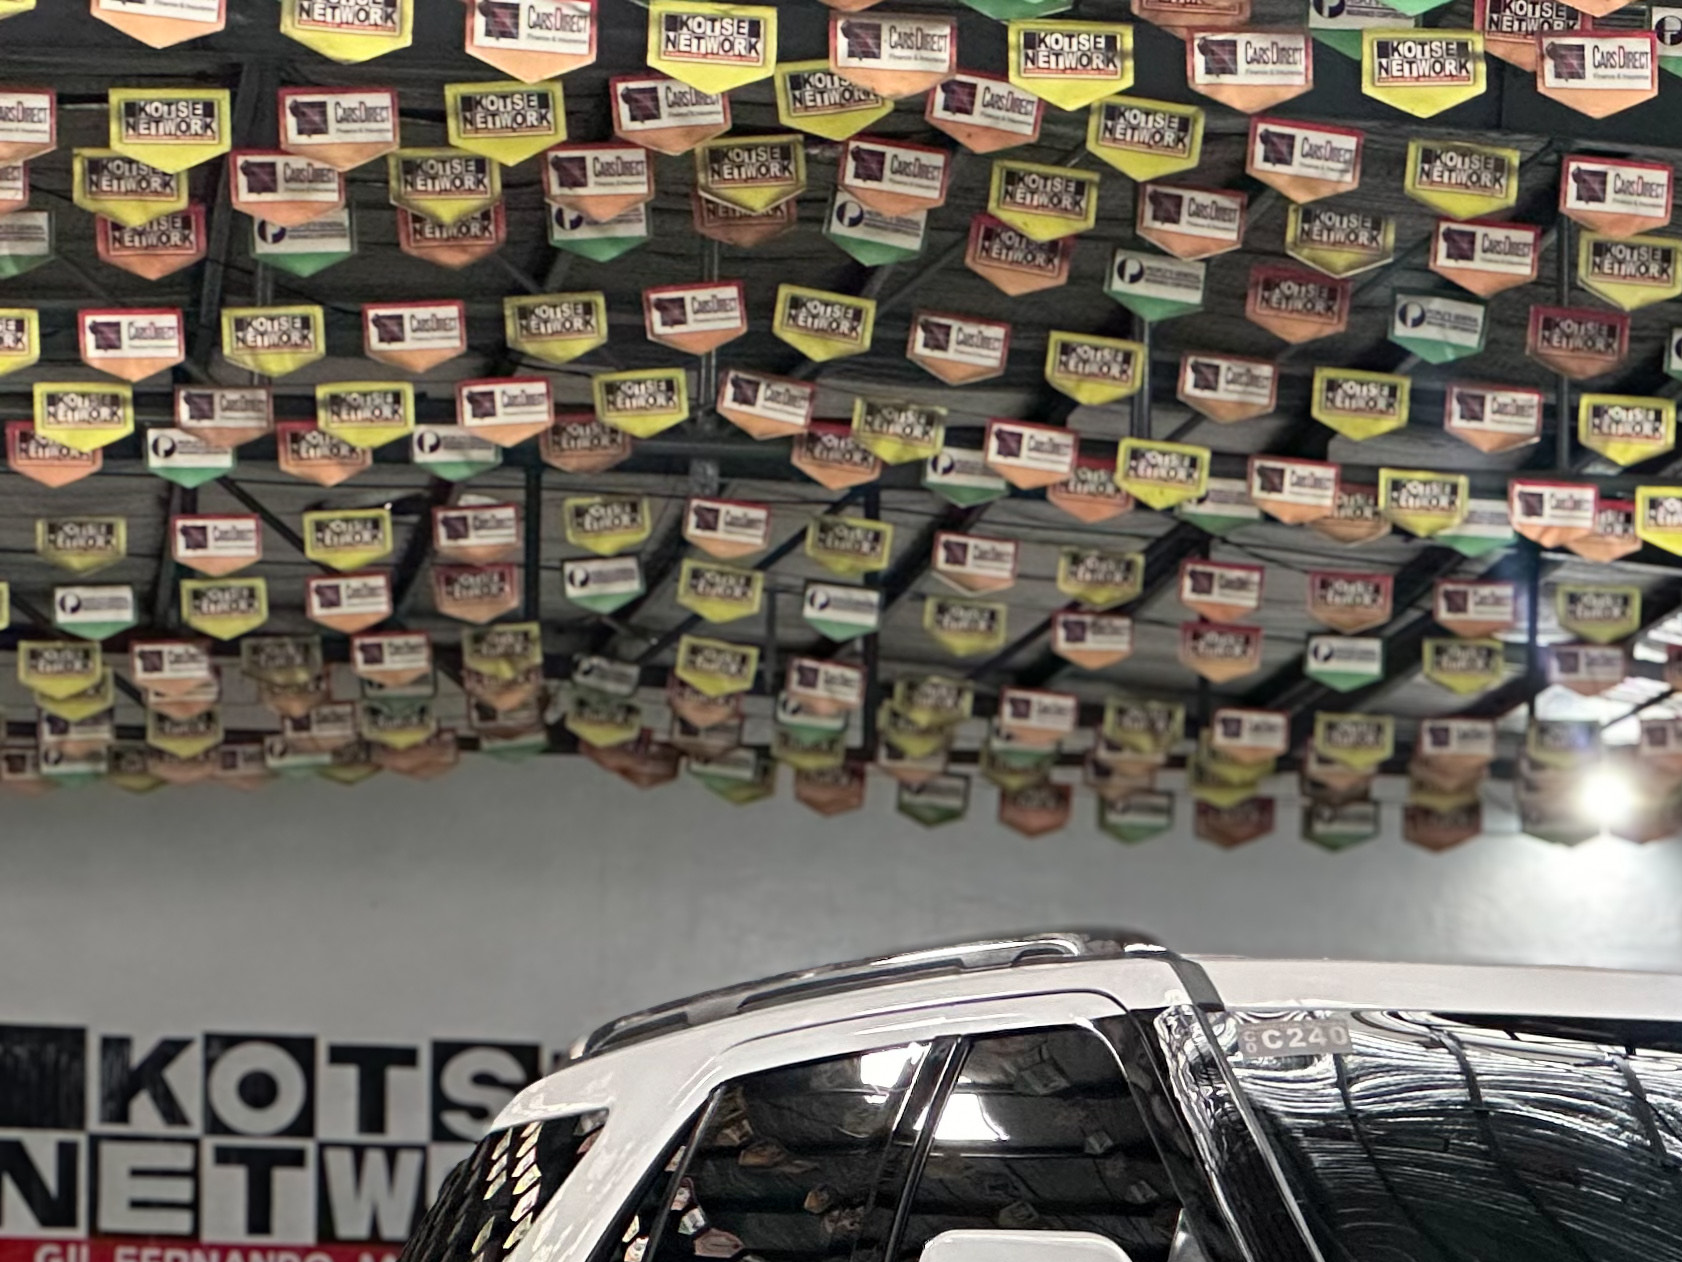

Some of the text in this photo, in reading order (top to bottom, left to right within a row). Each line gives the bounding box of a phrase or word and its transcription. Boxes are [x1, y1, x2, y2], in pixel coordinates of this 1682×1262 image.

[300, 6, 397, 26] NETWORK
[1502, 0, 1565, 18] KOTSE
[1245, 41, 1303, 66] CARSDIRECT
[1593, 45, 1650, 69] CARSDIRECT
[0, 103, 47, 124] ARSDIRECT
[1261, 1026, 1348, 1049] C240
[100, 1036, 534, 1140] KOTS
[0, 1141, 440, 1242] NETW
